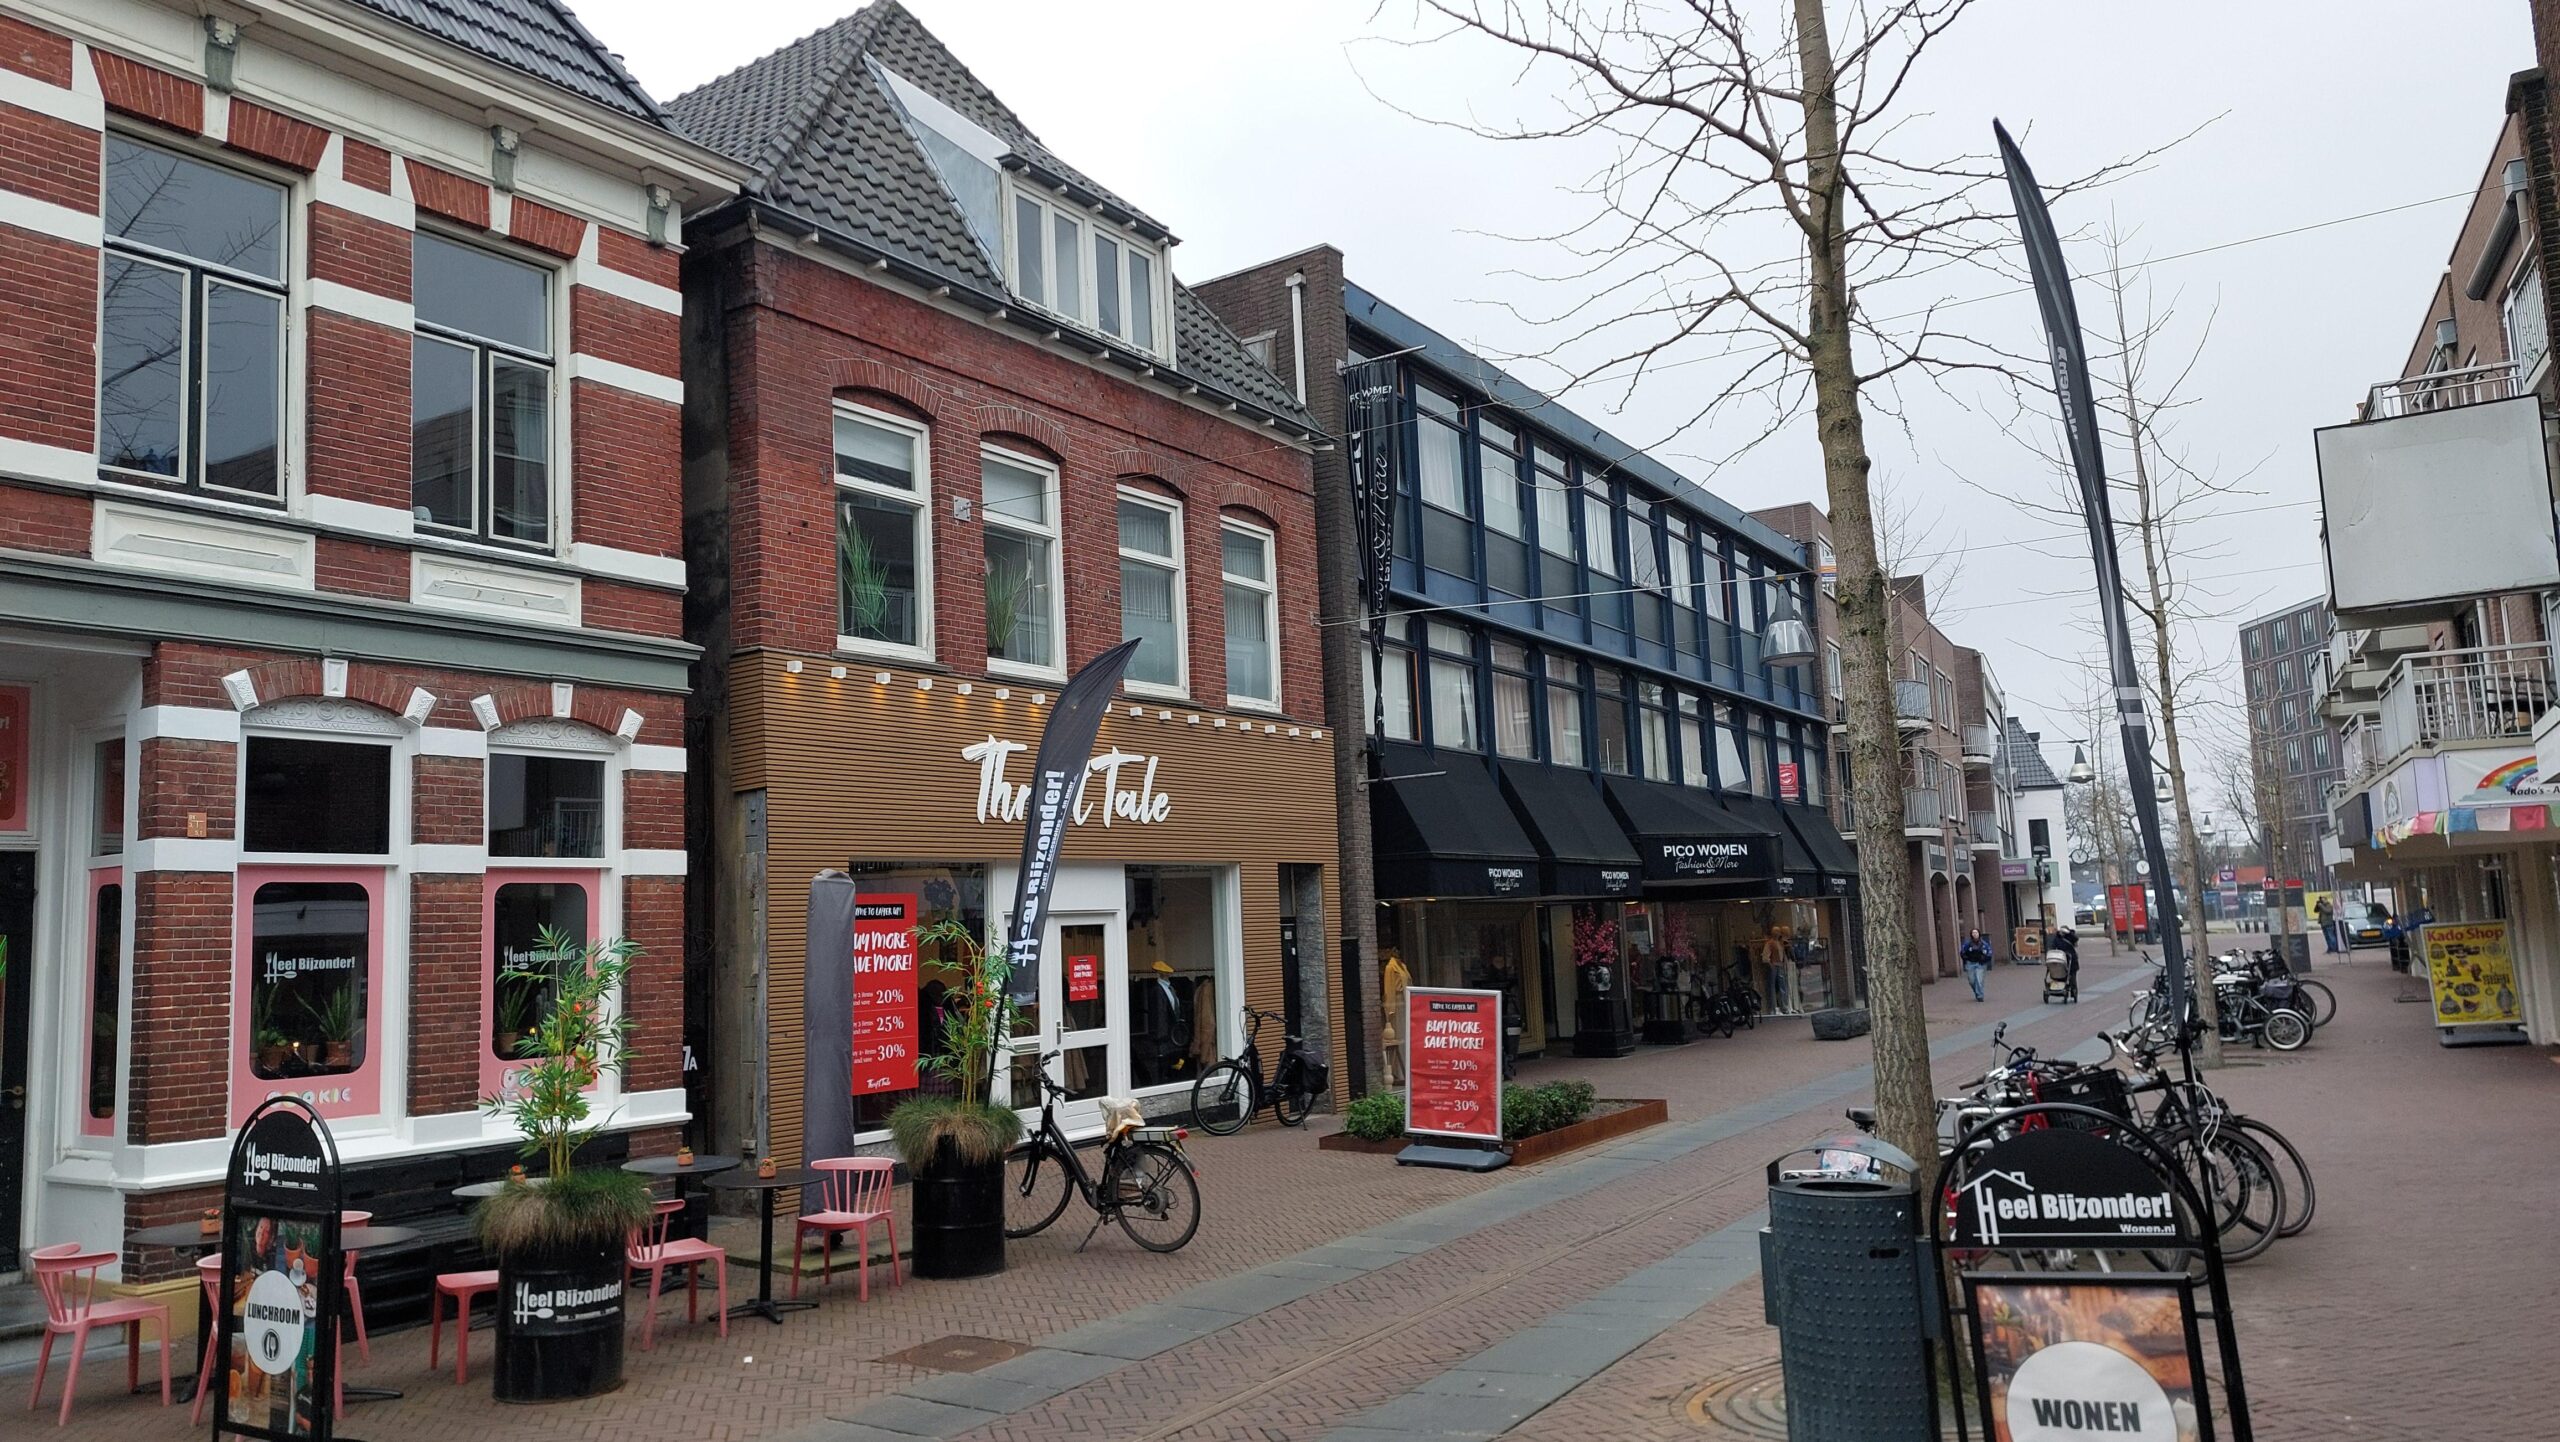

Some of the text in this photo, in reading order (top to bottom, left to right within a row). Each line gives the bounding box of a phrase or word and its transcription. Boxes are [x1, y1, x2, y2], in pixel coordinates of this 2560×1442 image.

[961, 734, 1171, 828] Thrt Tale
[1663, 844, 1748, 857] PICO WOMEN
[1489, 868, 1523, 878] PICO WOMEN
[1613, 871, 1629, 880] WOMEN
[868, 907, 875, 916] TO
[876, 907, 892, 917] LAYER
[2427, 926, 2504, 942] Kado Shop
[854, 933, 870, 952] UY
[264, 951, 356, 984] Heel Bijzonder!
[873, 953, 913, 973] MORE!
[876, 989, 904, 1004] 20%
[876, 1016, 904, 1032] 25%
[1426, 1020, 1447, 1034] BUY
[1424, 1035, 1484, 1050] SAVE MORE!
[878, 1044, 905, 1061] 30%
[1451, 1059, 1478, 1071] 20%
[1454, 1079, 1479, 1091] 25%
[1454, 1100, 1479, 1112] 30%
[244, 1142, 321, 1187] Heel Bijzonder!
[1974, 1180, 2173, 1245] Heel Bijzonder!
[2119, 1223, 2176, 1234] Wonen.nl
[513, 1282, 554, 1325] Heel
[555, 1279, 622, 1307] Bijzonder!
[247, 1302, 300, 1325] LUNCHROOM
[2031, 1398, 2142, 1433] WONEN
